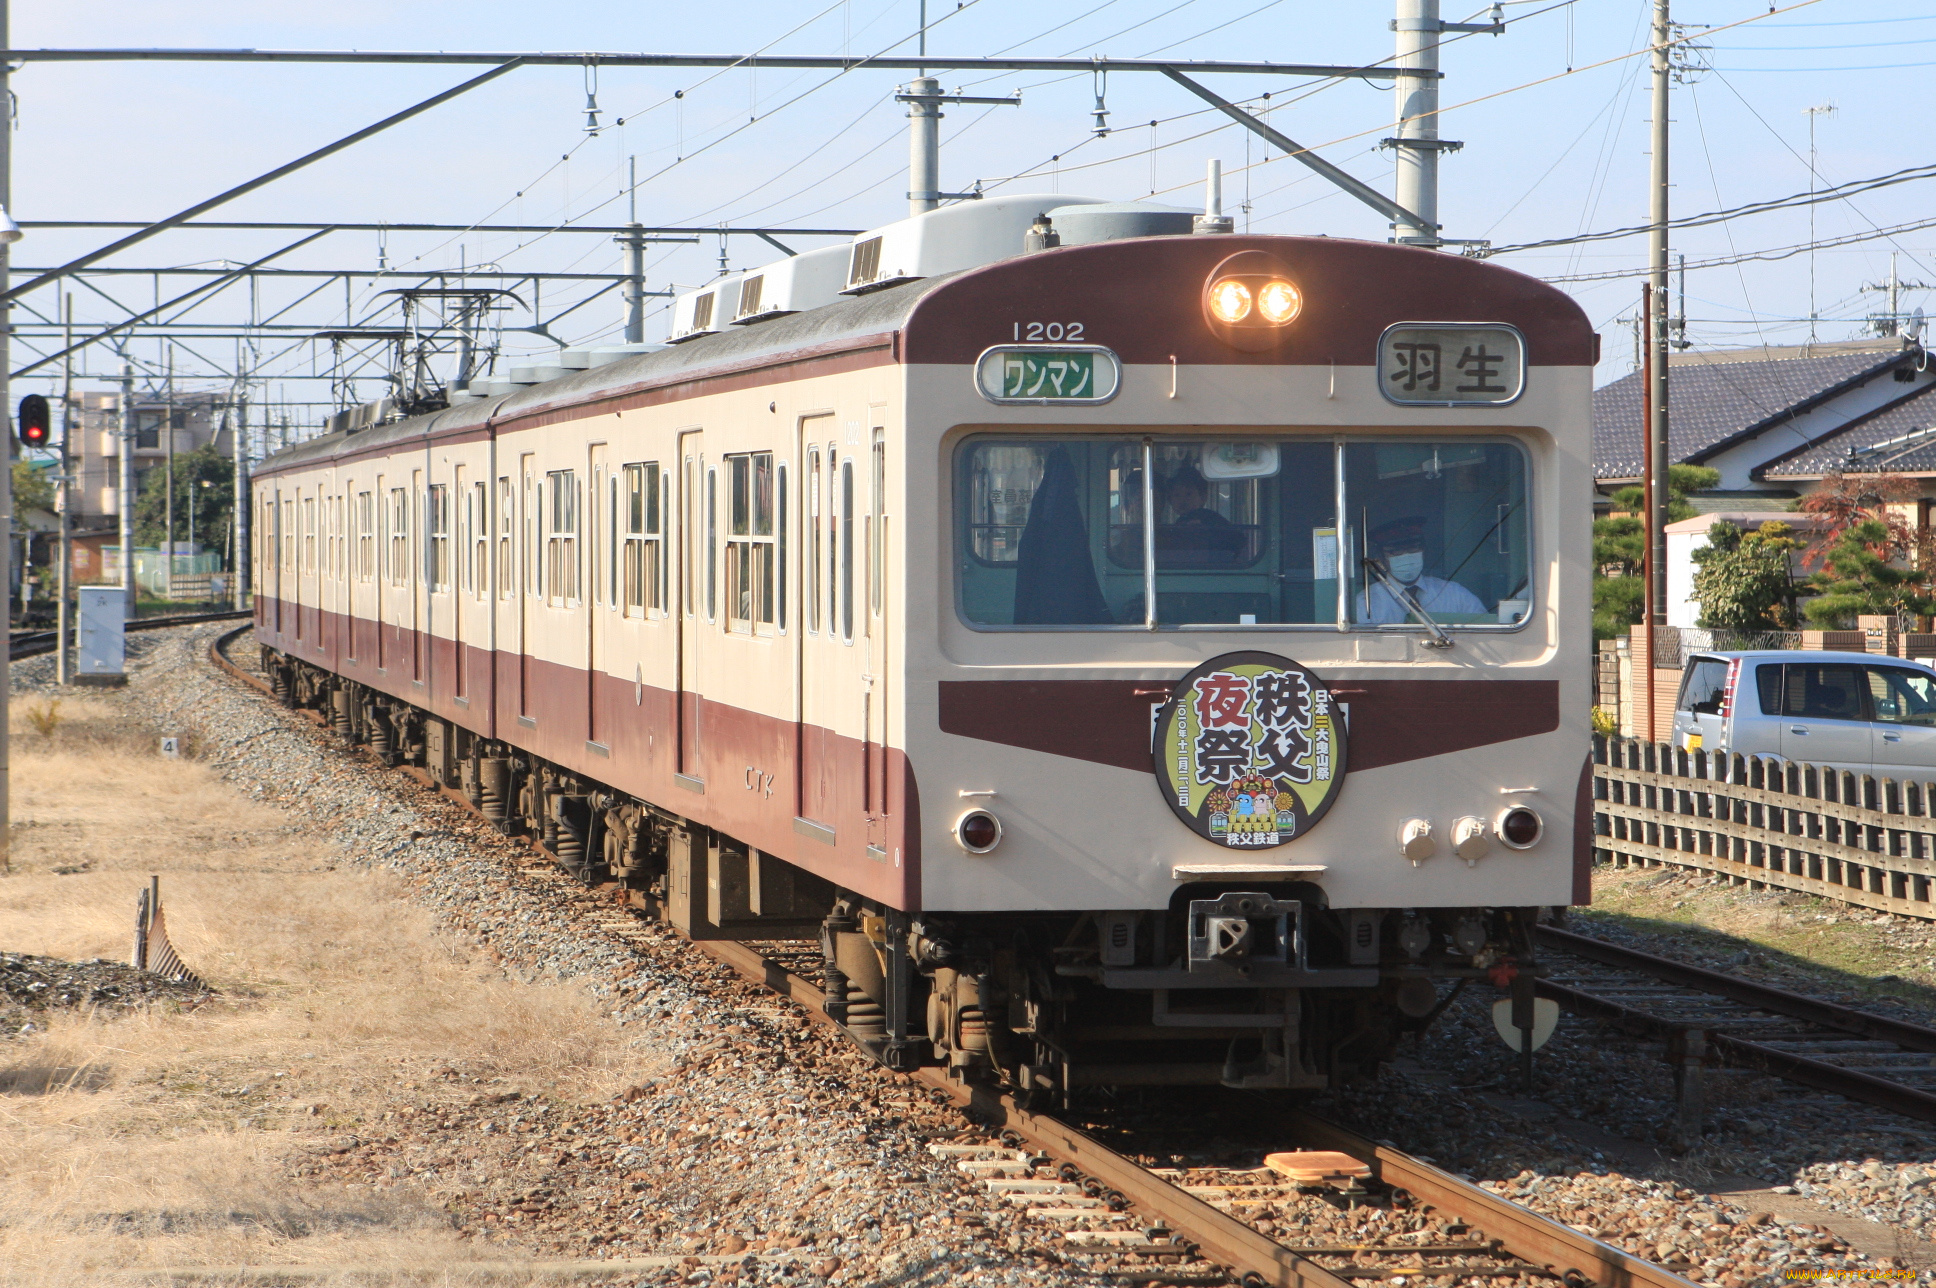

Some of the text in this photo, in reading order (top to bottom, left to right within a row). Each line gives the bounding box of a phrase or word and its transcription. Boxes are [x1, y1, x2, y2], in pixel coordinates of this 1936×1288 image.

[1014, 322, 1084, 341] 1202
[1006, 360, 1089, 396] ワンマン
[1391, 343, 1506, 392] 羽生
[1194, 672, 1251, 784] 夜祭
[1254, 671, 1312, 783] 秩父
[1315, 690, 1330, 781] 日本三大曳山祭
[163, 741, 174, 752] 4
[745, 766, 774, 800] CTK
[1226, 832, 1280, 846] 秩父鉄道
